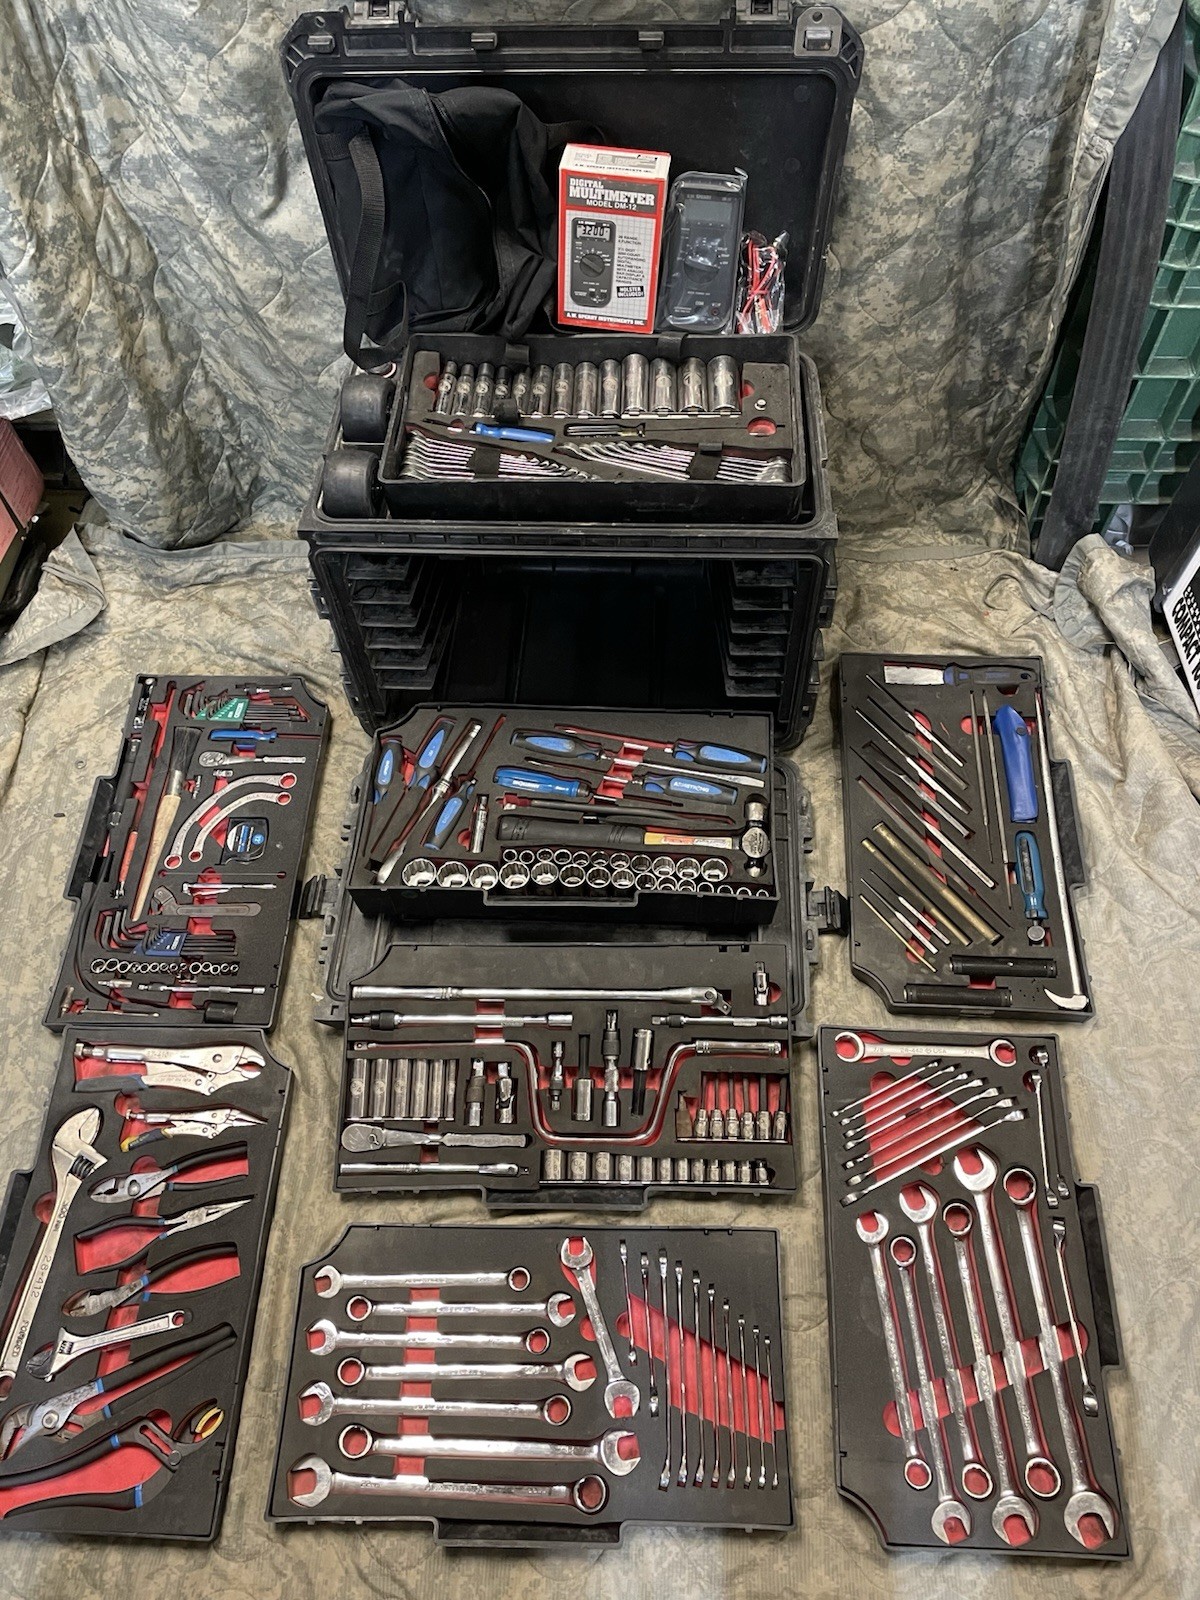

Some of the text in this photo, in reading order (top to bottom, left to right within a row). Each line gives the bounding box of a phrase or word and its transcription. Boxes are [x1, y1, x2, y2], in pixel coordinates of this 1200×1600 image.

[569, 177, 604, 189] DIGITAL
[569, 185, 655, 206] MULTIMETER
[586, 199, 637, 211] MODEL DM-12
[577, 313, 598, 321] SPERRY
[597, 315, 634, 325] INSTRUMENTS
[1172, 597, 1200, 665] COMPACT
[31, 1254, 53, 1299] 28-412
[11, 1319, 29, 1358] FORGED
